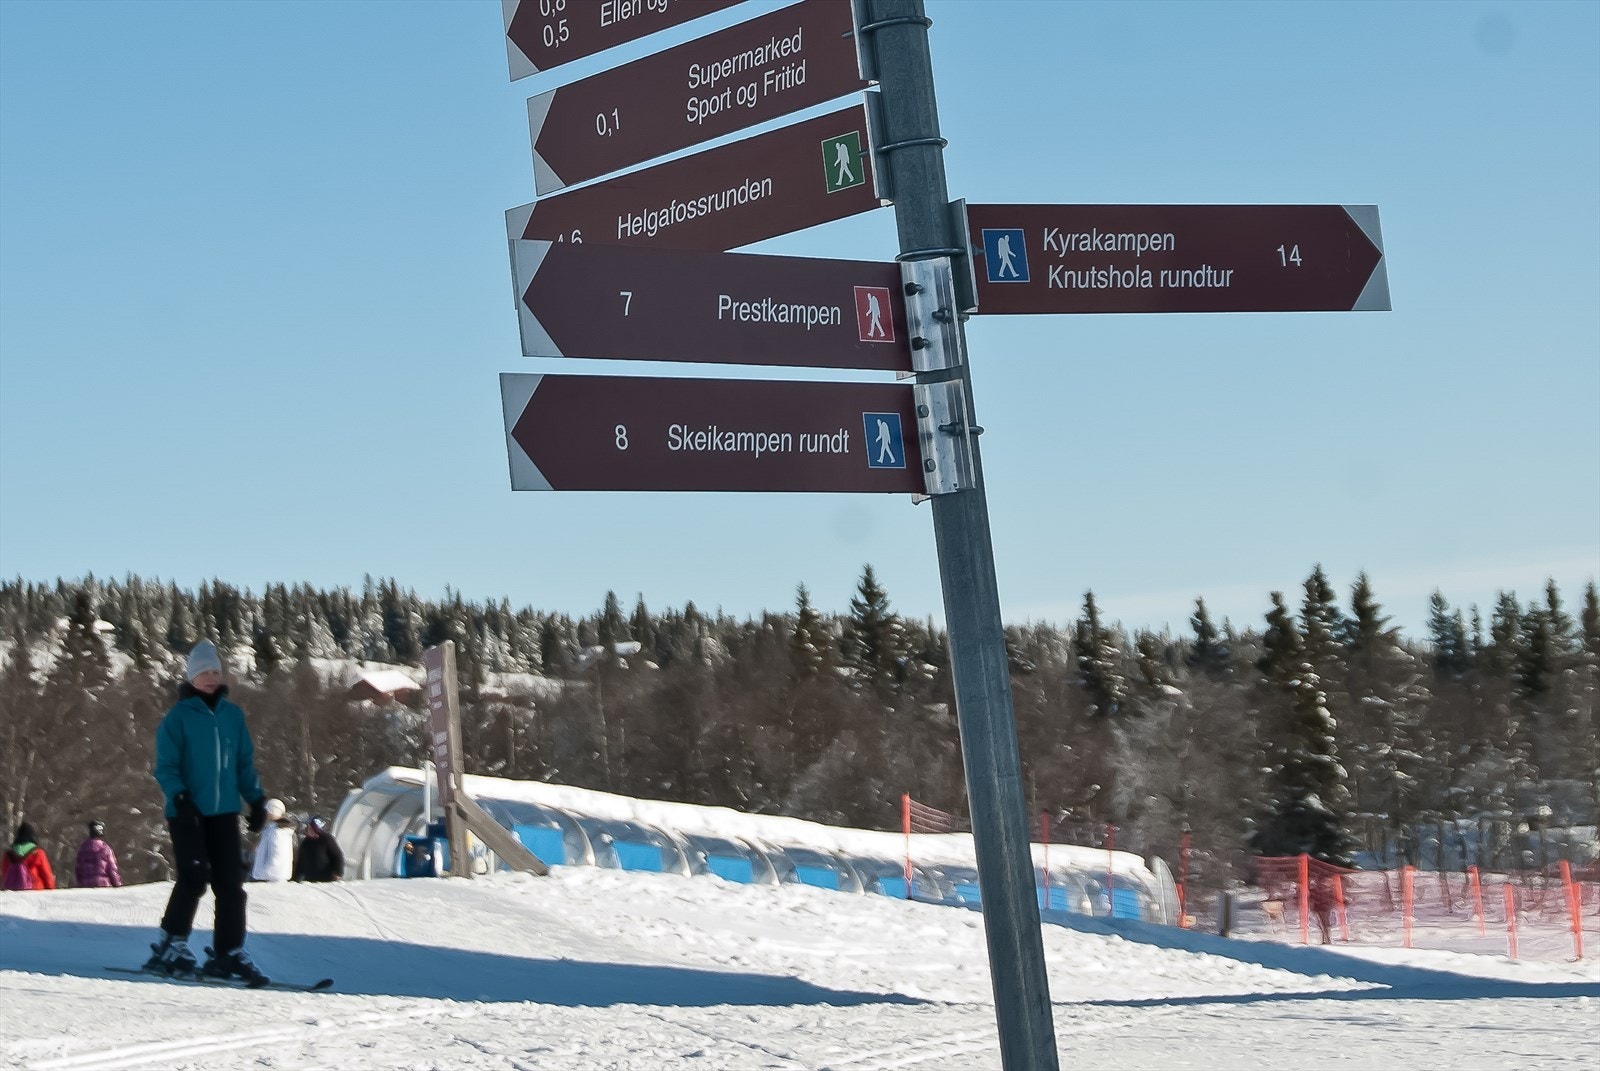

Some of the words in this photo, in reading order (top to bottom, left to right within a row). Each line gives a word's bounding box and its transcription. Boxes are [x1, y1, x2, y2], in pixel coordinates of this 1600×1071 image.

[600, 0, 642, 28] Ellen
[543, 18, 570, 48] 0,5
[688, 27, 803, 90] Supermarked
[686, 83, 732, 124] Sport
[736, 79, 758, 108] og
[763, 58, 807, 97] Fritid
[596, 107, 621, 138] 0,1
[617, 177, 773, 241] Helgafossrunden
[1043, 227, 1175, 258] Kyrakampen
[1277, 244, 1303, 268] 14
[1048, 264, 1153, 290] Knutshola
[1160, 264, 1234, 289] rundtur
[620, 291, 632, 317] 7
[718, 294, 841, 331] Prestkampen
[614, 424, 628, 451] 8
[667, 423, 792, 459] Skeikampen
[799, 427, 850, 454] rundt
